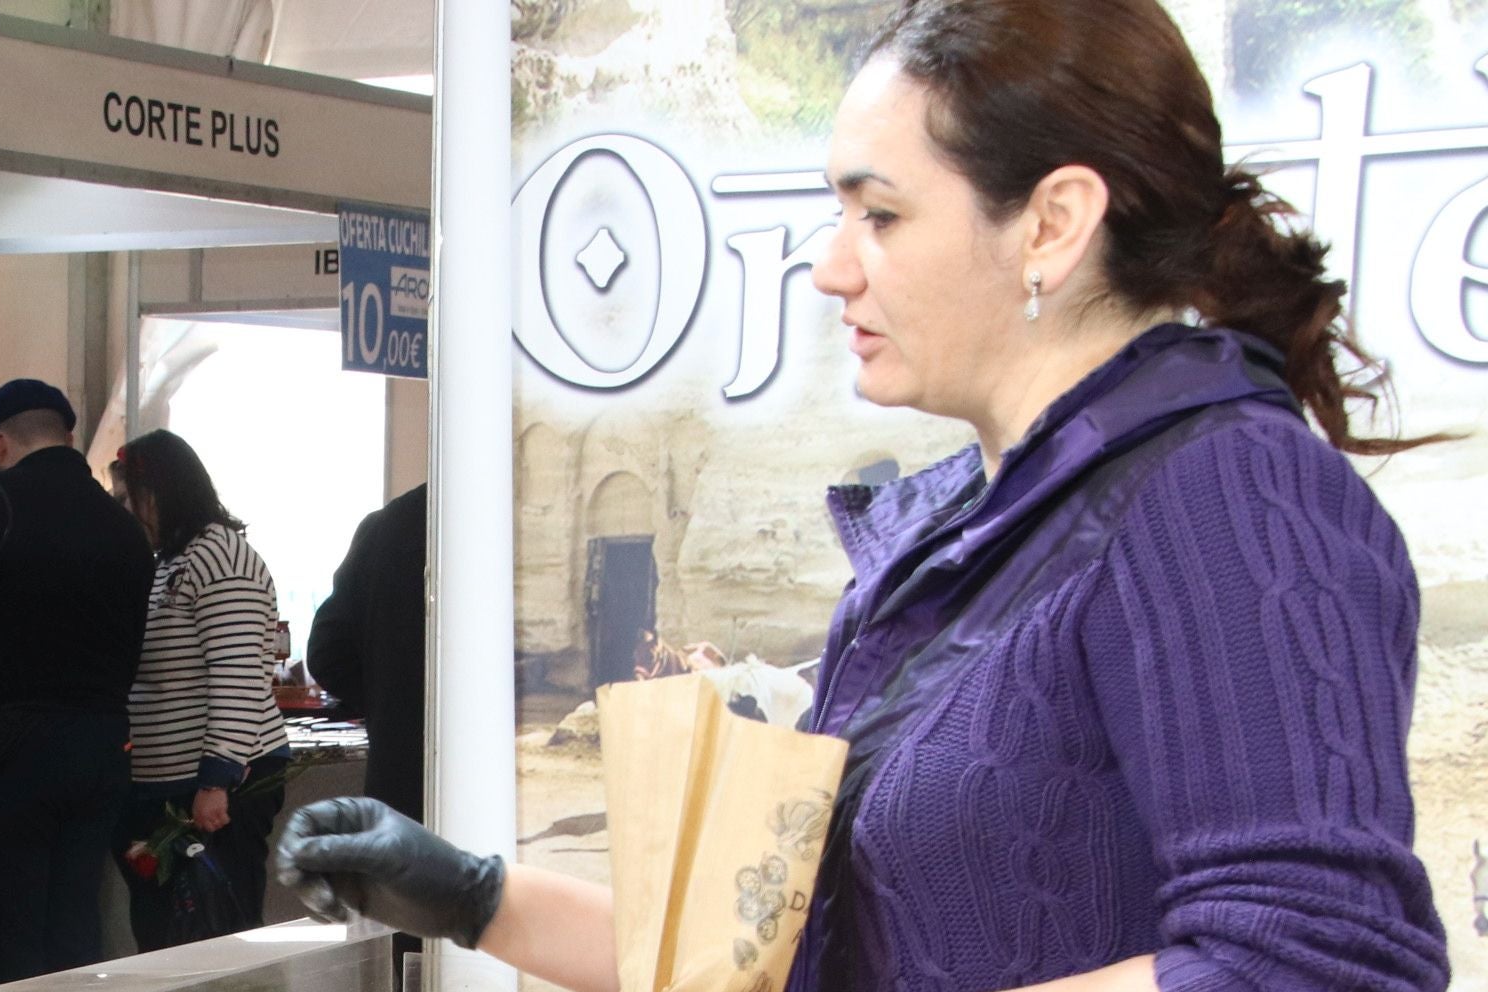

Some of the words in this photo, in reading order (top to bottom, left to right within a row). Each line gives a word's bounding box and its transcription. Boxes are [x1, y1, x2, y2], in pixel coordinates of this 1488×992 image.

[103, 91, 203, 146] CORTE
[211, 110, 280, 158] PLUS
[340, 211, 386, 251] OFERTA
[388, 218, 430, 259] CUCHIL
